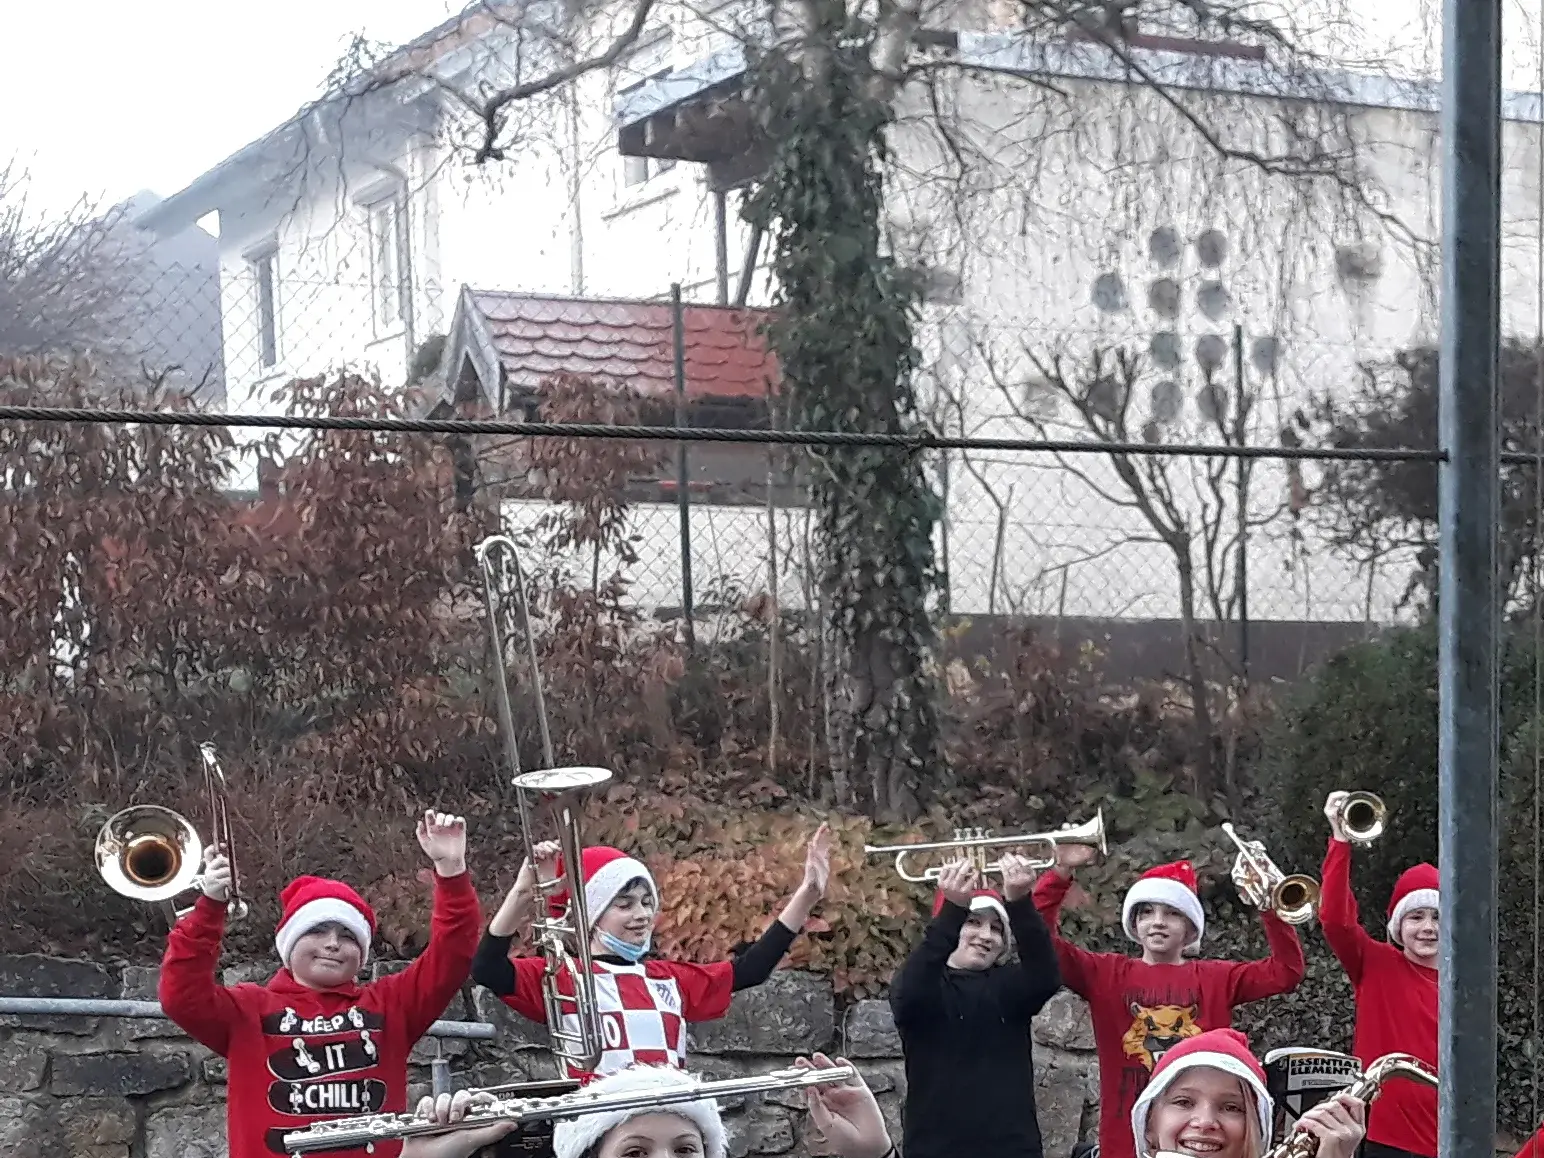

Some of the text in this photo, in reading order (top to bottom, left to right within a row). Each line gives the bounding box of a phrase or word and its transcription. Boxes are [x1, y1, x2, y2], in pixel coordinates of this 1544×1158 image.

[301, 1015, 345, 1034] KEEP
[324, 1043, 346, 1070] IT
[1291, 1058, 1360, 1070] ESSENTIAL
[1291, 1066, 1354, 1076] ELEMENT
[304, 1083, 361, 1109] CHILL
